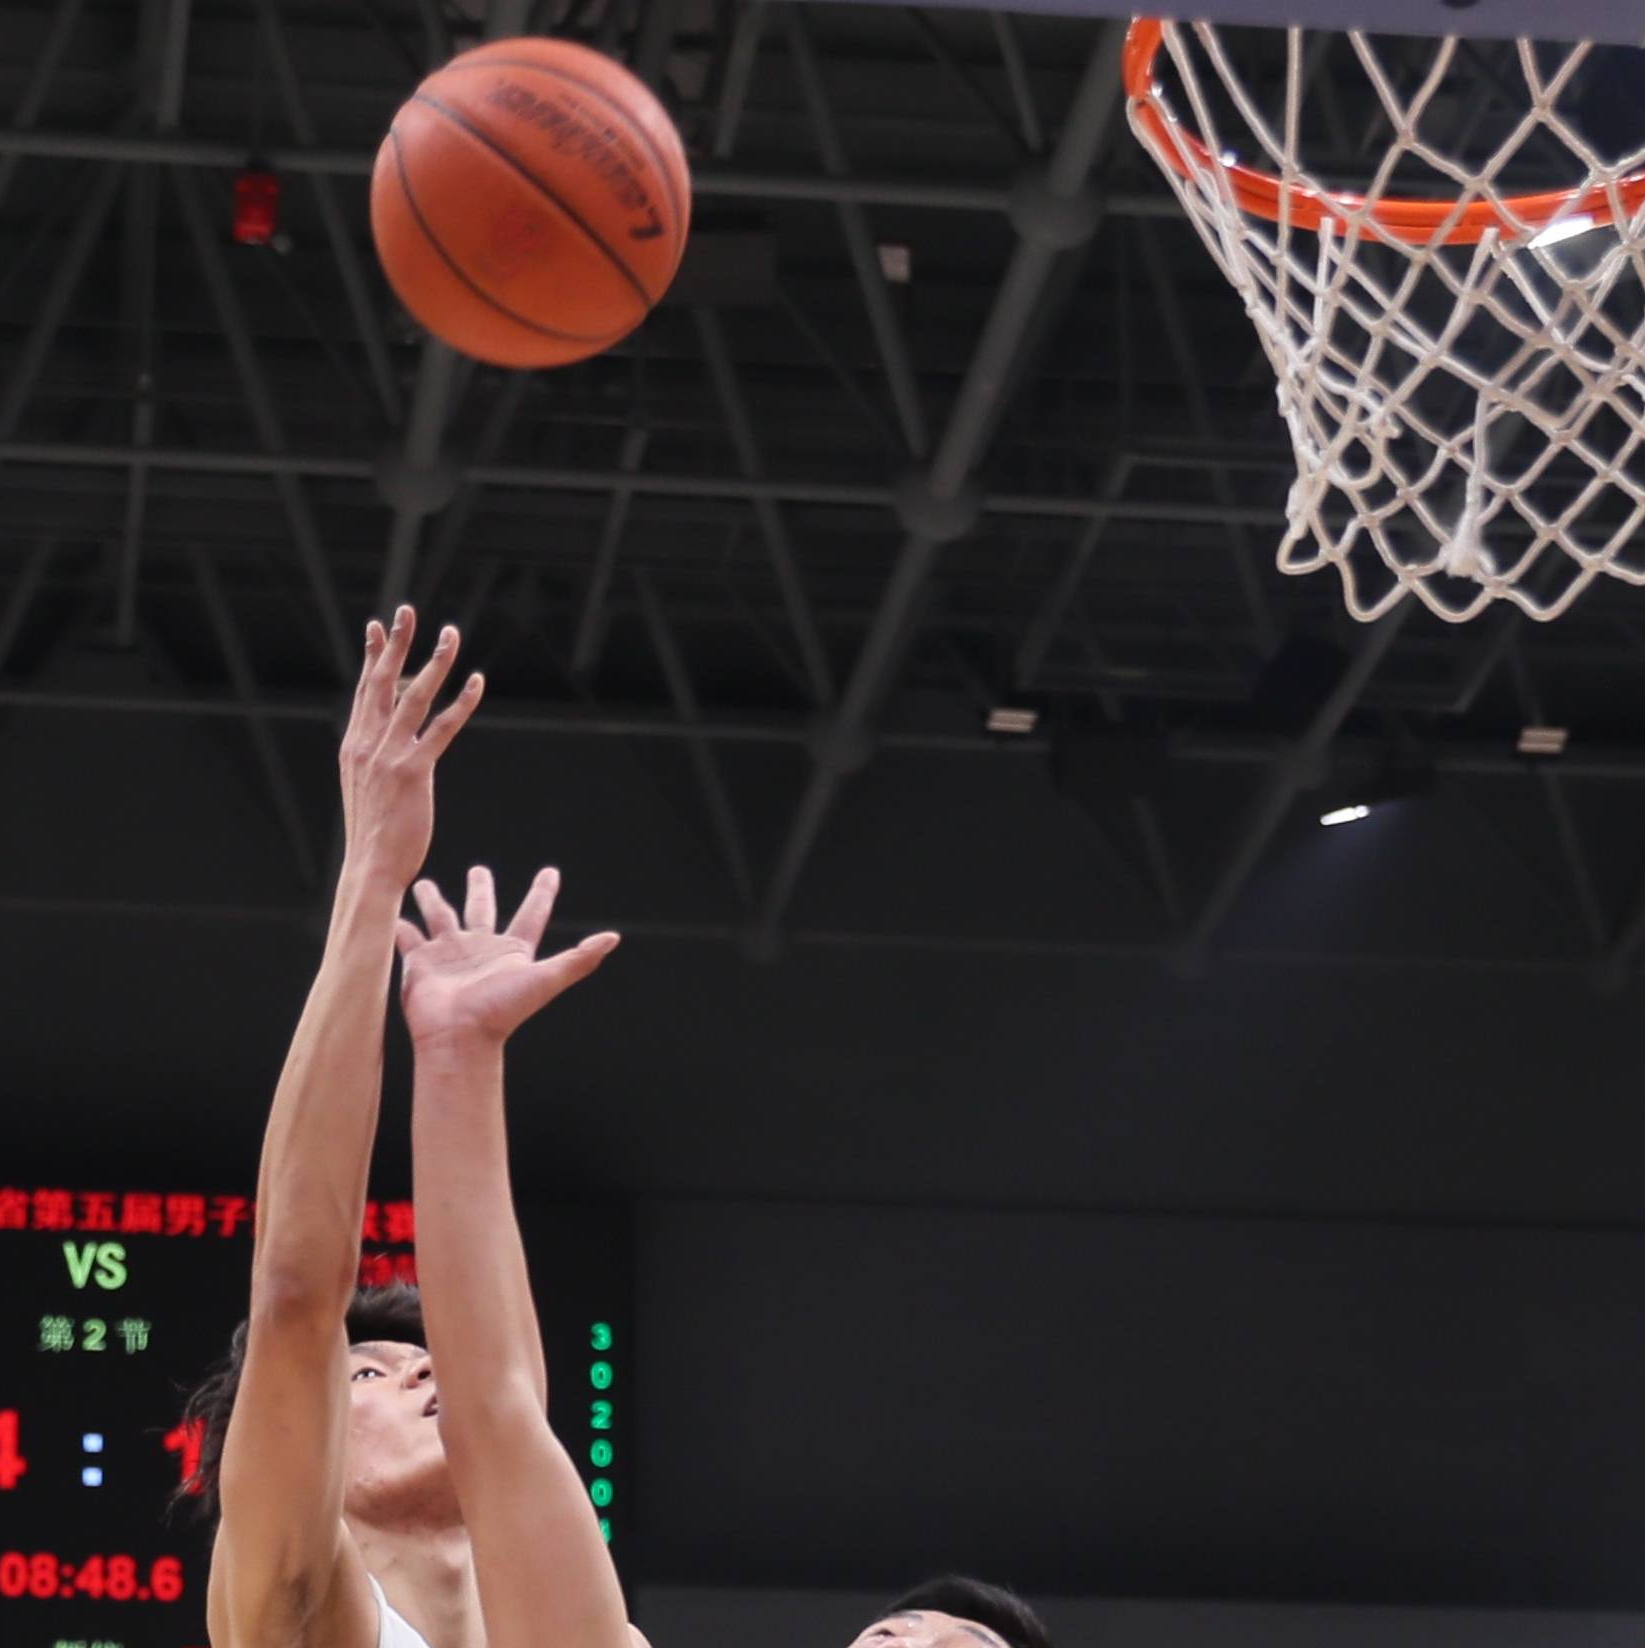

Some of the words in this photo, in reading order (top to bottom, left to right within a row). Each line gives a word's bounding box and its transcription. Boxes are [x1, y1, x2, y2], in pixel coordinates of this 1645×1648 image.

[63, 1242, 126, 1289] VS
[591, 1323, 612, 1350] 3
[590, 1361, 612, 1389] 0
[591, 1401, 612, 1429] 2
[590, 1439, 612, 1467] 0
[591, 1479, 613, 1507] 0
